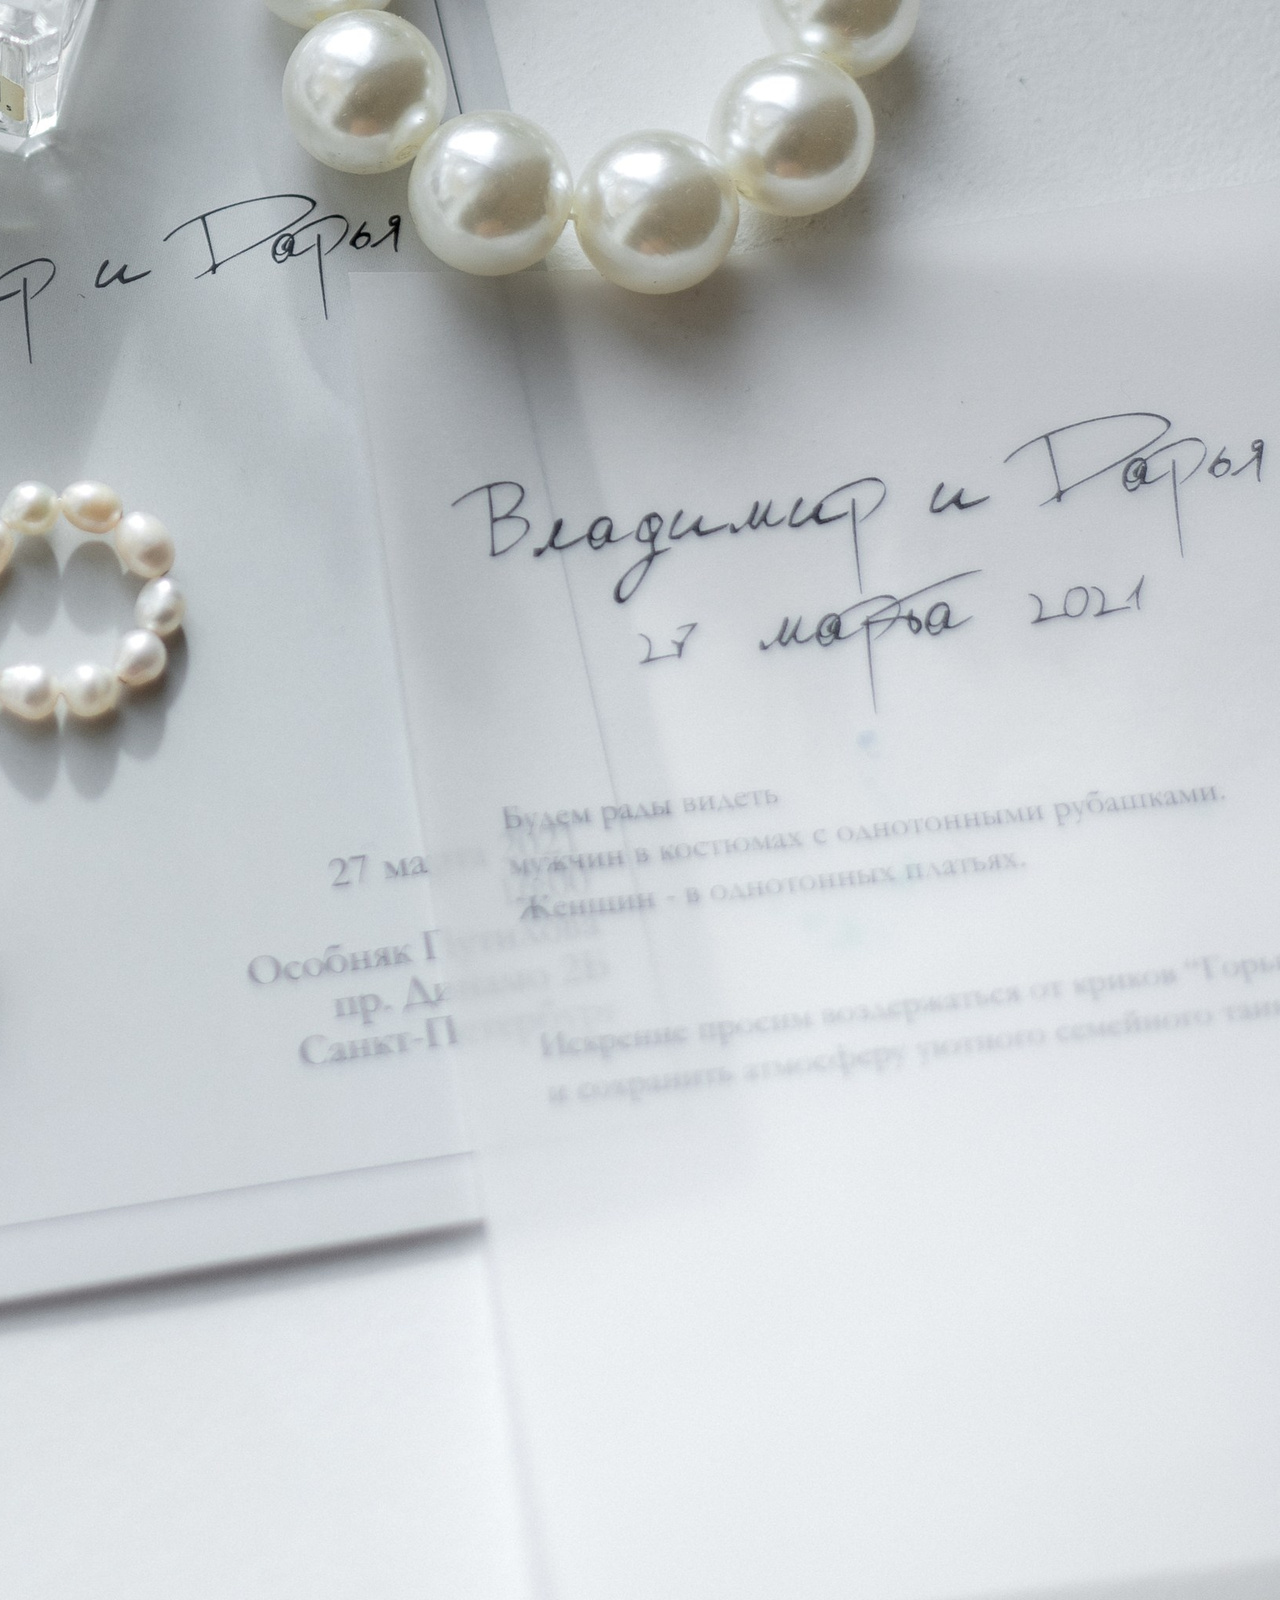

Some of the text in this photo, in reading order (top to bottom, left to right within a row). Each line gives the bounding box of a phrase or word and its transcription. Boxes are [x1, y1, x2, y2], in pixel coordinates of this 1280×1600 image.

[95, 258, 150, 285] и
[163, 194, 401, 320] Дарья
[452, 412, 1264, 602] Владимир и Дарья
[639, 622, 697, 664] 27
[1028, 575, 1145, 624] 2021
[502, 787, 779, 835] Будем рады видеть
[636, 845, 650, 864] в
[661, 832, 801, 863] костюмах
[813, 827, 828, 845] с
[836, 803, 1045, 843] однотонными
[1054, 783, 1227, 827] рубашками.
[328, 854, 369, 889] 27
[686, 885, 701, 904] в
[709, 861, 897, 902] однотонных
[905, 848, 1028, 881] платьях.
[247, 941, 412, 987] Особняк
[334, 991, 393, 1026] пр.
